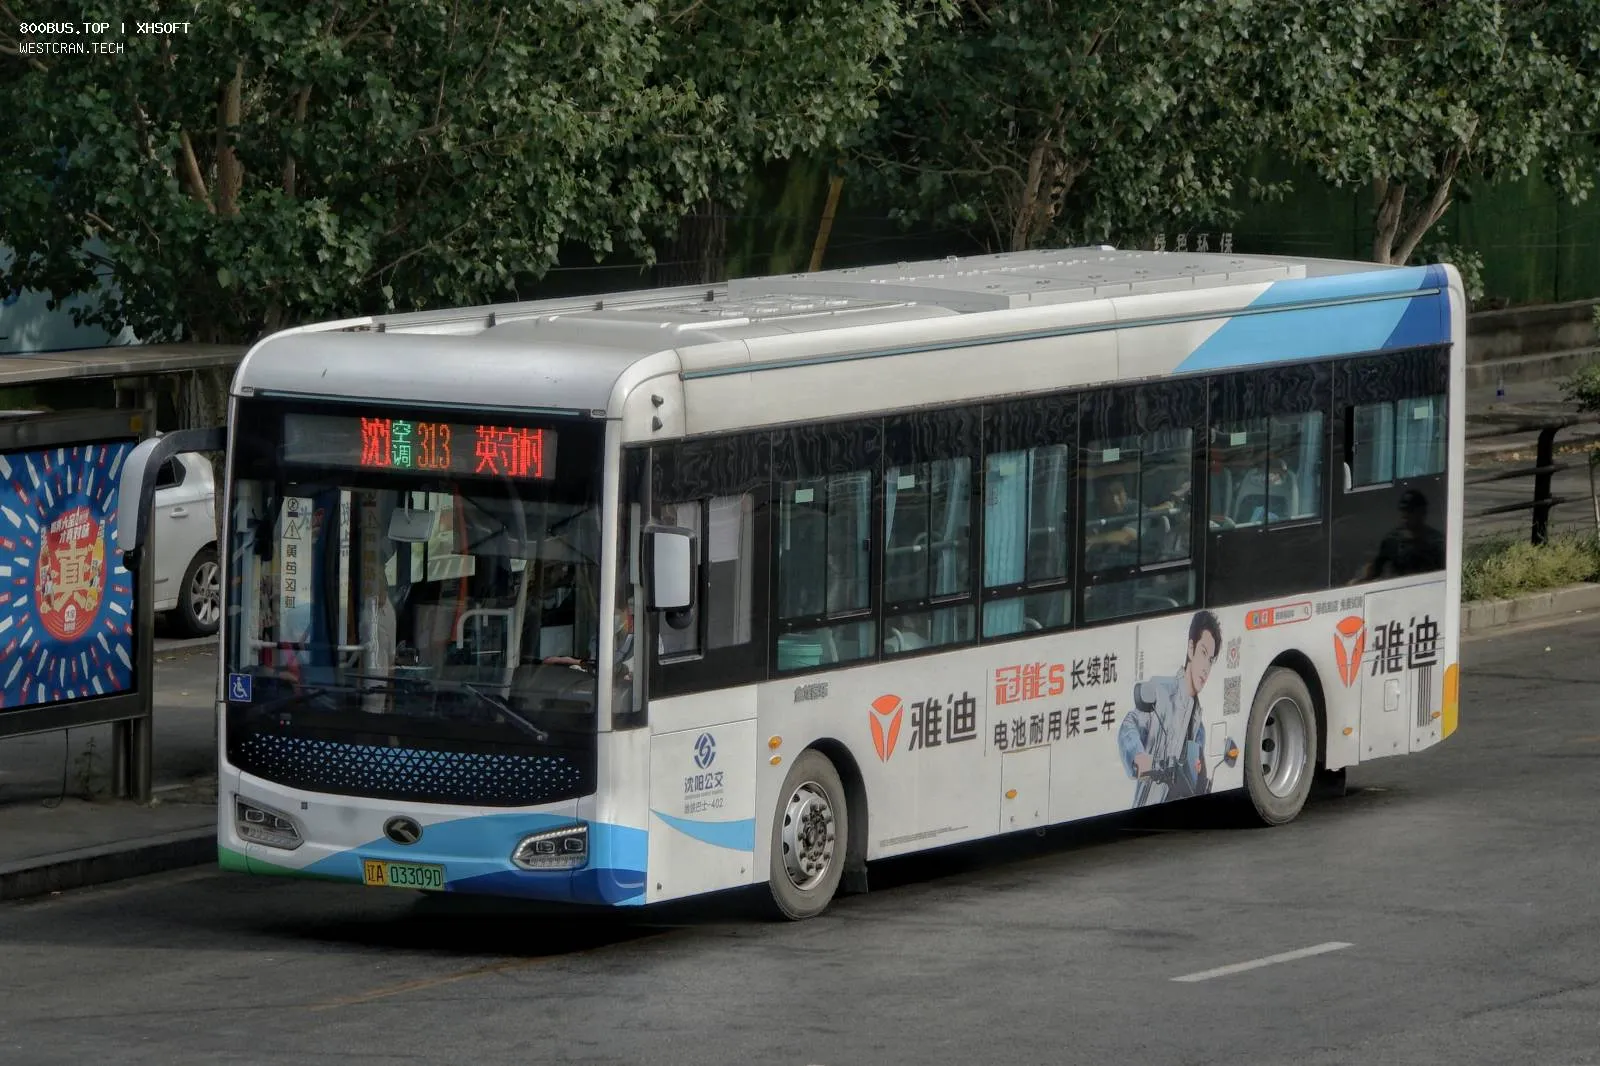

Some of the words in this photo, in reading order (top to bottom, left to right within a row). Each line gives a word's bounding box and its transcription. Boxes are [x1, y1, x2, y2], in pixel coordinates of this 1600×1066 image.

[392, 420, 411, 468] 空调
[417, 423, 451, 469] 313
[475, 425, 543, 478] 英守村
[1371, 614, 1438, 677] 雅迪
[995, 661, 1065, 705] 冠能S
[1070, 653, 1118, 691] 长续航
[908, 691, 977, 751] 雅迪
[993, 700, 1116, 750] 电池耐用保三年
[684, 771, 724, 793] 沈阳公交
[390, 866, 441, 887] 03309D
